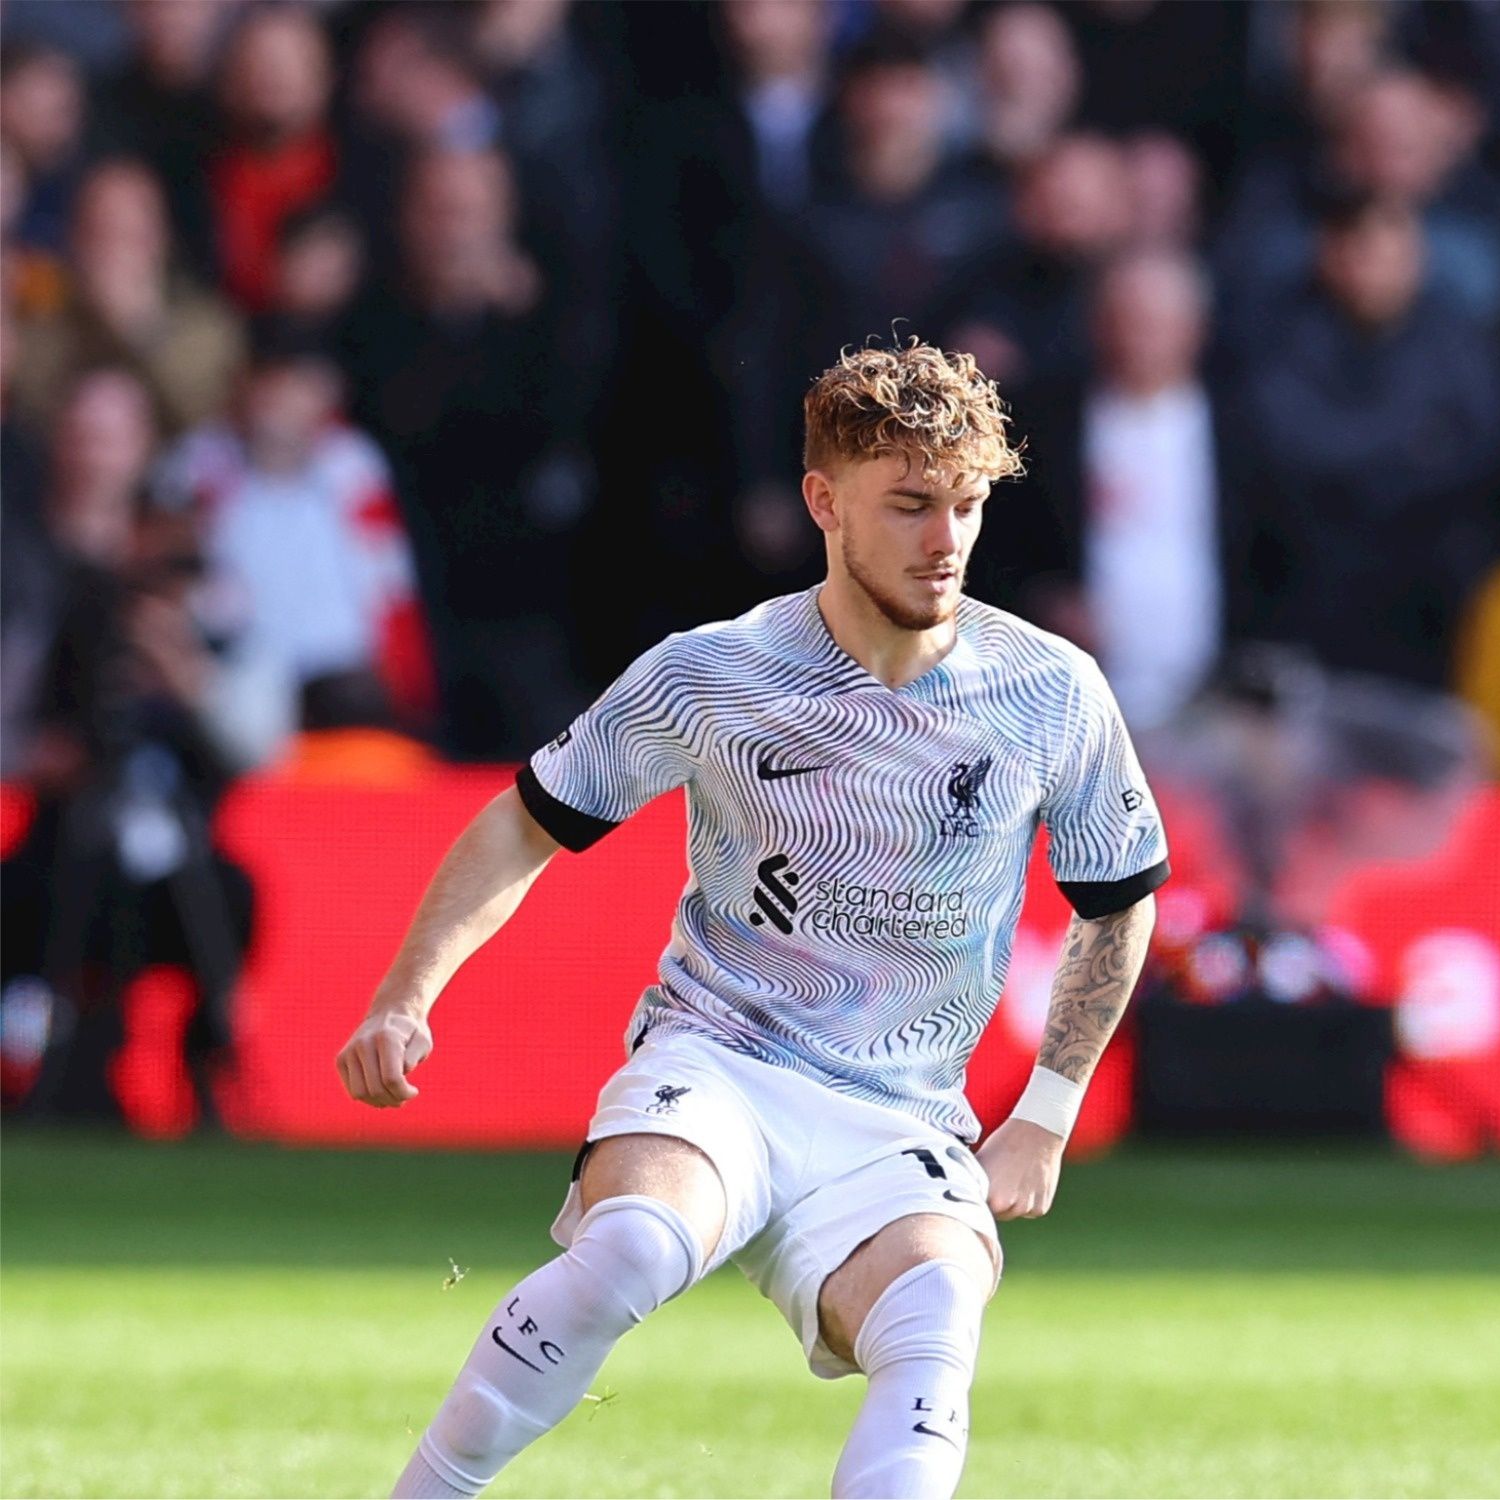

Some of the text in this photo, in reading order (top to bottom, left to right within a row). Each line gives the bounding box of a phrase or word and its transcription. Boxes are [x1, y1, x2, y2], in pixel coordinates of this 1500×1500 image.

[939, 820, 979, 838] LFC
[814, 878, 965, 913] standard
[812, 907, 967, 940] chartered
[506, 1296, 565, 1366] LFC
